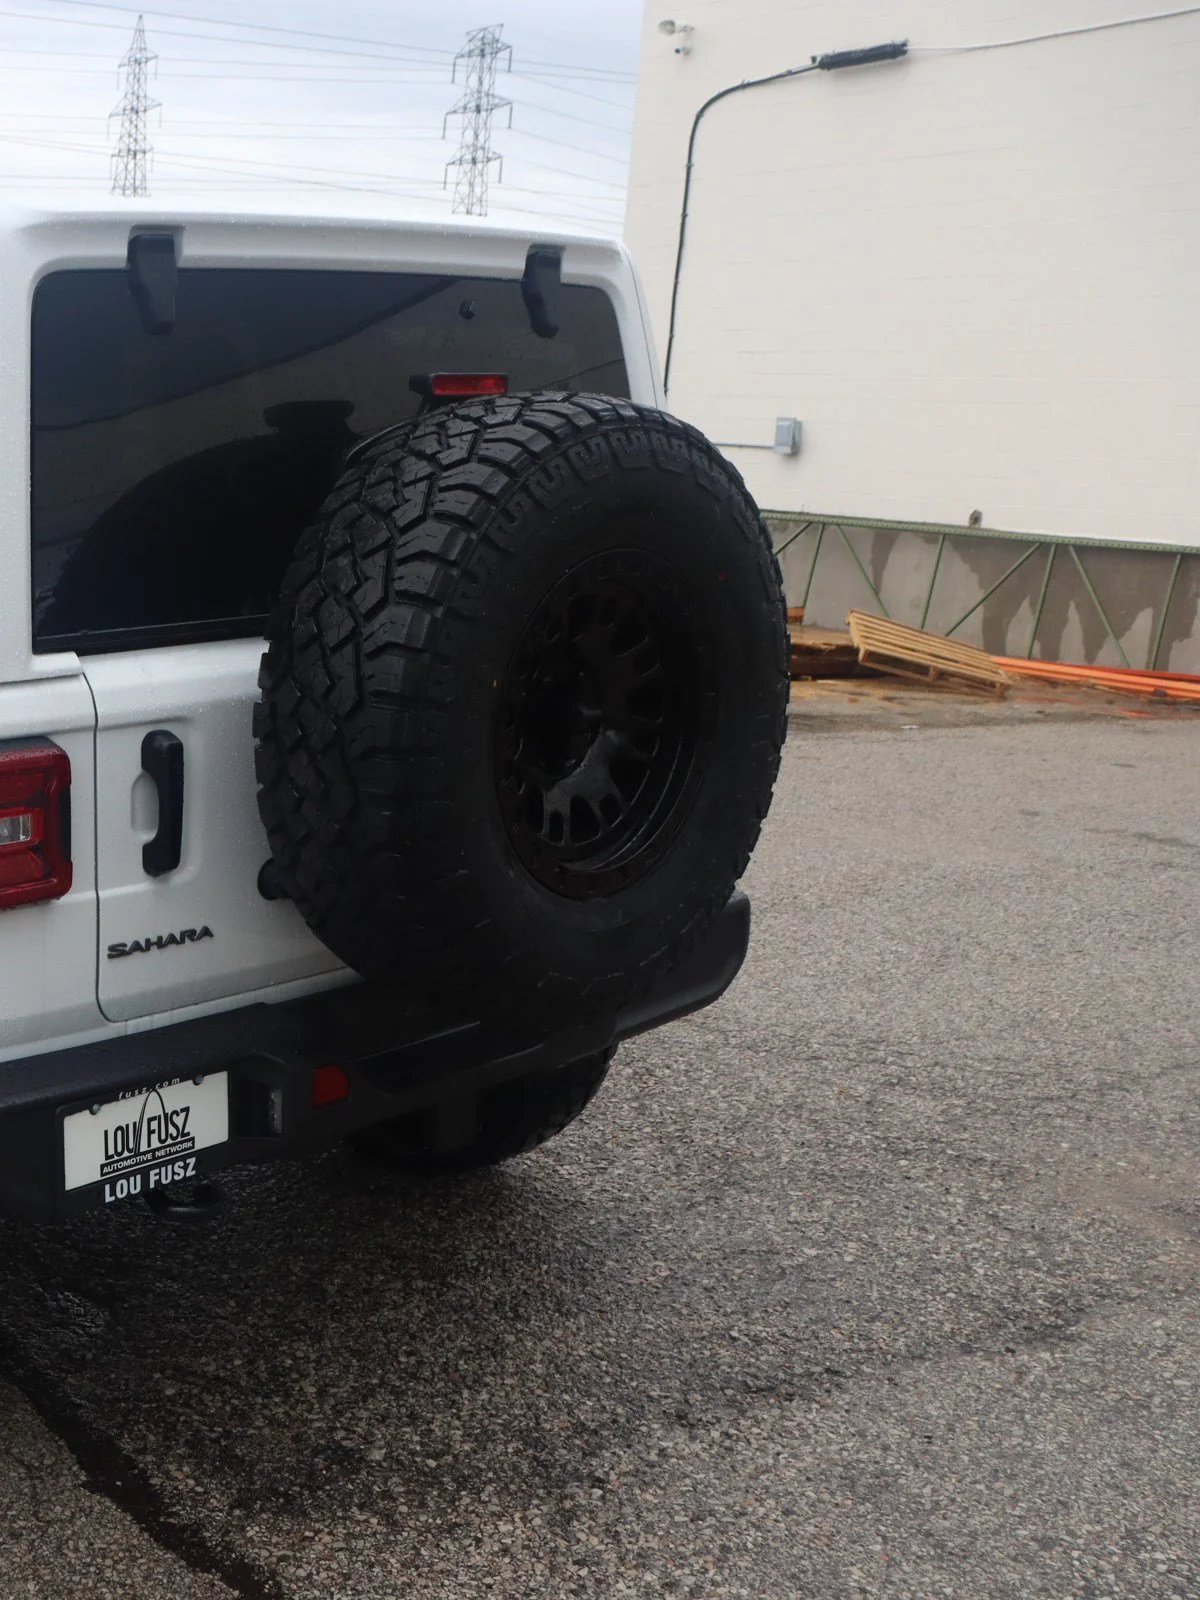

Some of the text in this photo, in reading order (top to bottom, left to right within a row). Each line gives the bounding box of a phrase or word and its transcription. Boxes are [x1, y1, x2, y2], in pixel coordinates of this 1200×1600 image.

[106, 925, 214, 960] SAHARA
[119, 1077, 180, 1100] fusz.com
[104, 1106, 190, 1161] LOU FUSZ
[102, 1140, 192, 1174] AUTOMOTIVE NETWORK
[104, 1158, 196, 1203] LOU FUSZ
